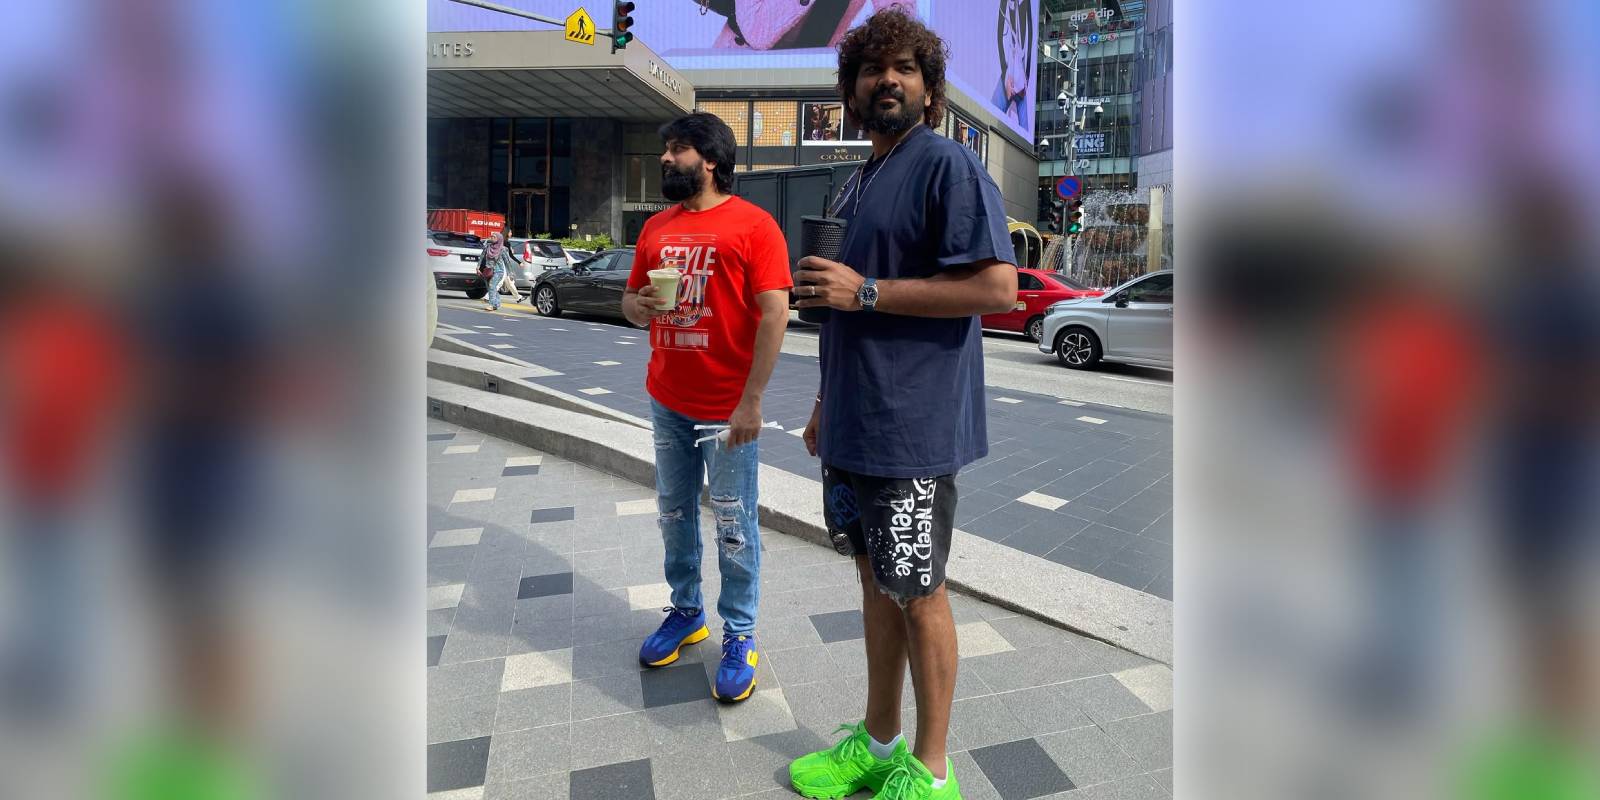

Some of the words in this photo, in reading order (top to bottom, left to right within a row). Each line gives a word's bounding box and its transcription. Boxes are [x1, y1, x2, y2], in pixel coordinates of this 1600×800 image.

[1096, 8, 1115, 20] dip
[1072, 138, 1104, 148] KING
[660, 245, 716, 276] STYLE
